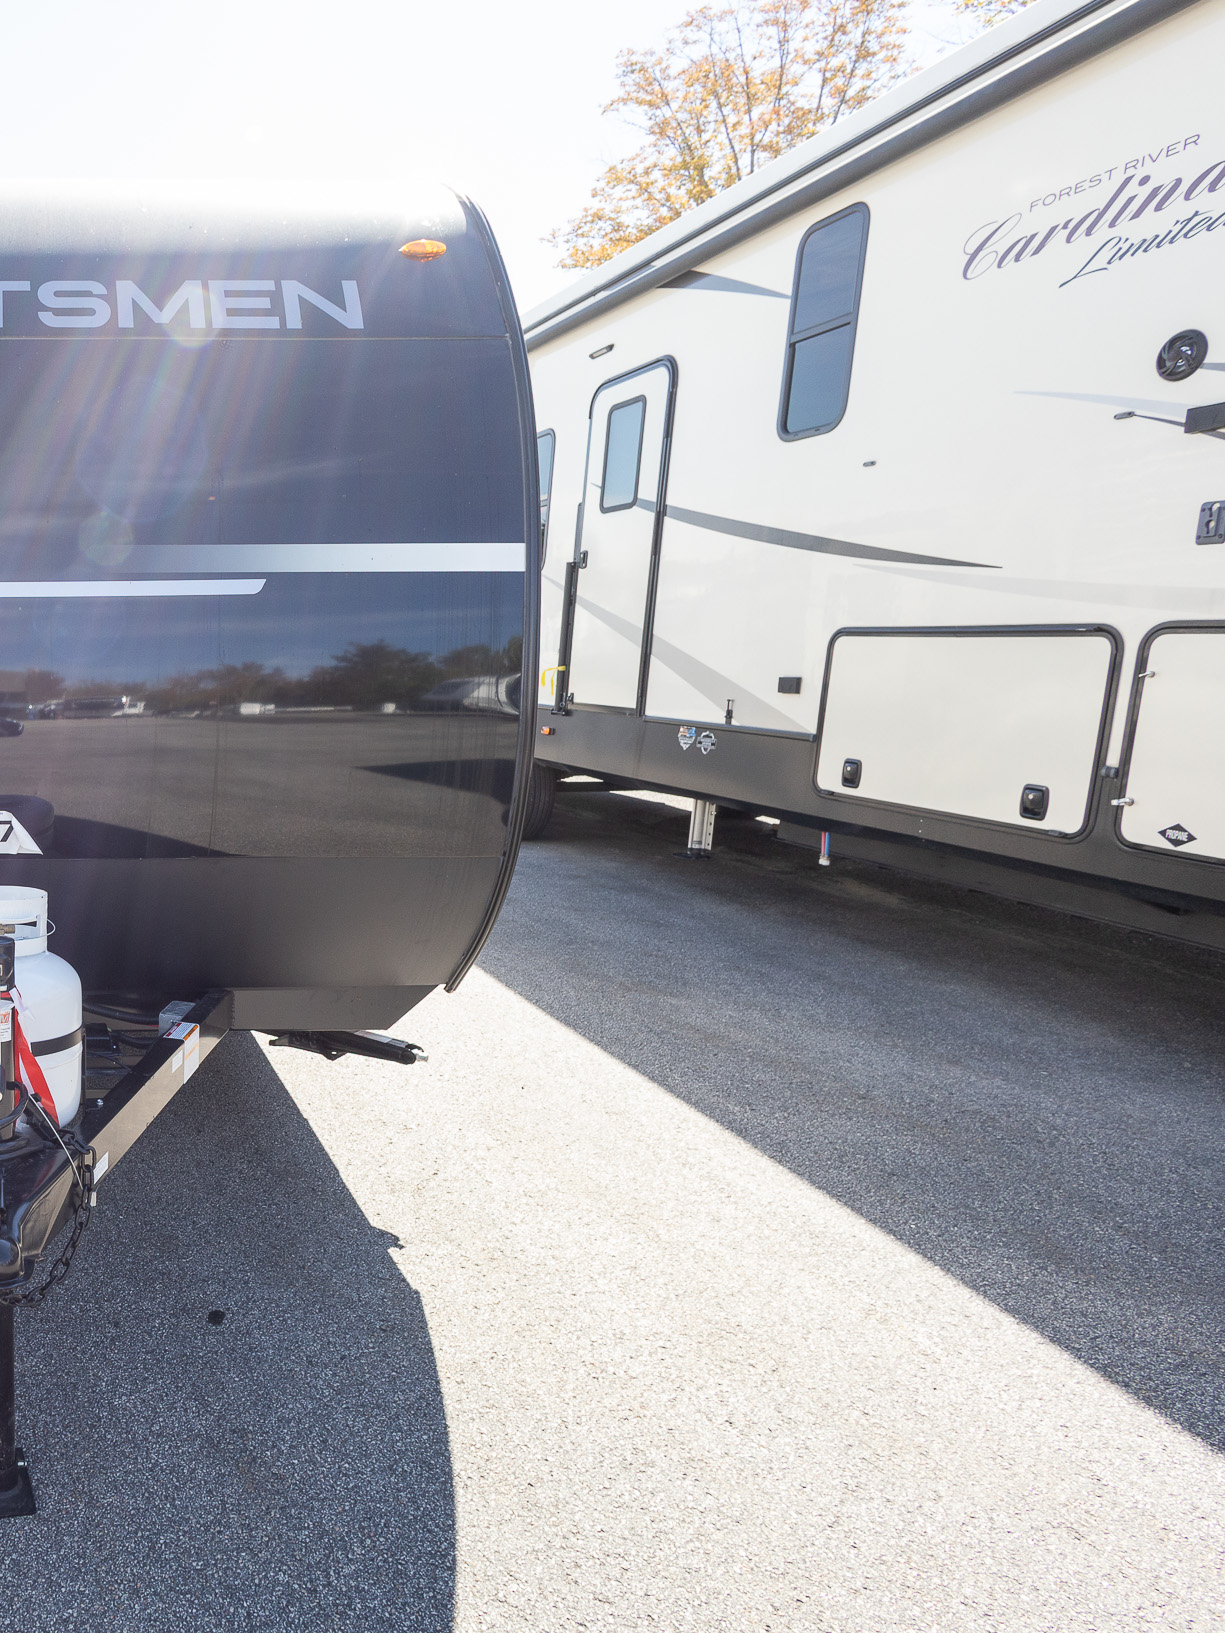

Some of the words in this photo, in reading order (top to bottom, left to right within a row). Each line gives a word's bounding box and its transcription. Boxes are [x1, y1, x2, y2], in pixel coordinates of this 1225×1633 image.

[1029, 166, 1119, 213] FOREST
[1123, 133, 1201, 175] RIVER
[1165, 828, 1189, 842] PROPANE
